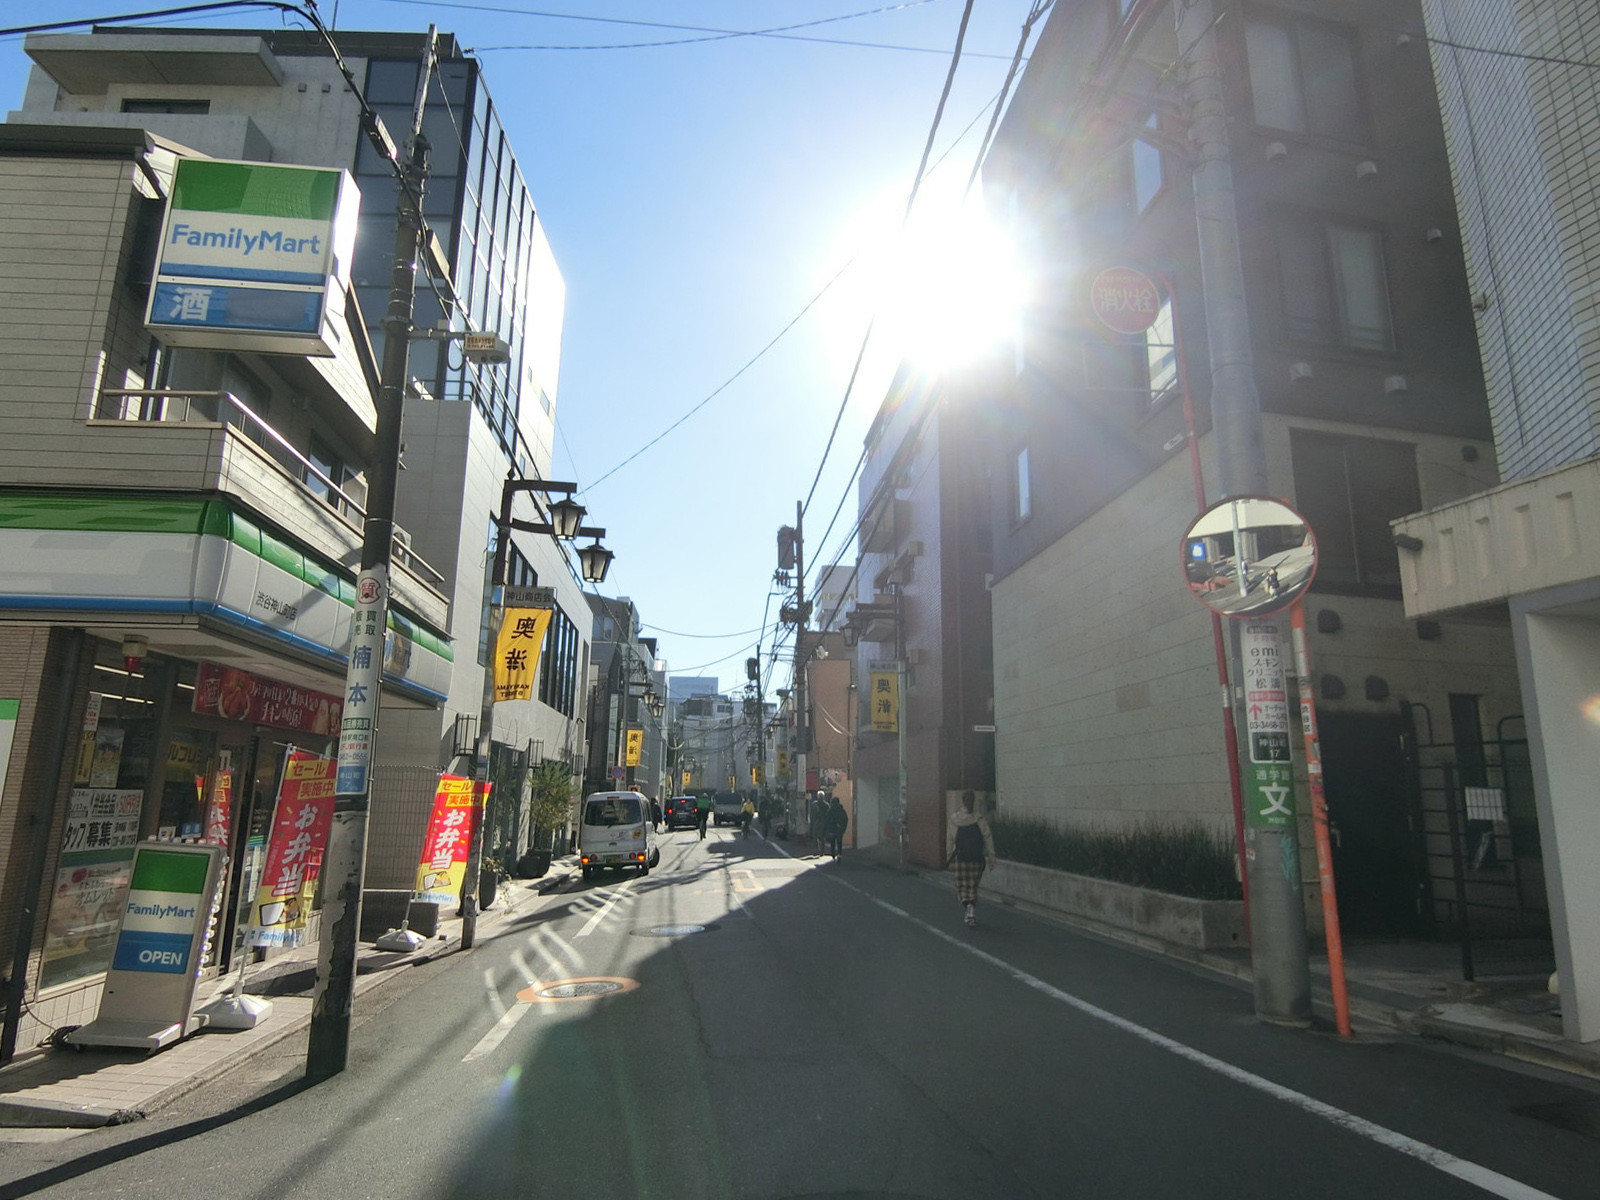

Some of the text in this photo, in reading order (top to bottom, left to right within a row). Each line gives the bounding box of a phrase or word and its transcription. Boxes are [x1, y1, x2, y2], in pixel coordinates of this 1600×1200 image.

[171, 223, 320, 255] FamilyMart
[169, 287, 212, 321] 酒
[1098, 287, 1154, 313] 消火栓
[256, 591, 298, 621] 渋谷神山町店
[365, 610, 377, 636] 買取
[1251, 644, 1279, 657] emi
[1247, 668, 1284, 677] クリニック
[1254, 658, 1279, 668] スキン
[348, 645, 373, 707] 楠本
[293, 762, 326, 778] セール
[300, 781, 335, 798] 実施中
[443, 782, 472, 791] セール
[448, 794, 481, 805] 実施中
[1258, 781, 1292, 816] 文
[273, 803, 319, 896] お弁当
[430, 809, 466, 869] お弁当
[127, 903, 195, 919] FamilyMart
[139, 950, 183, 965] OPEN
